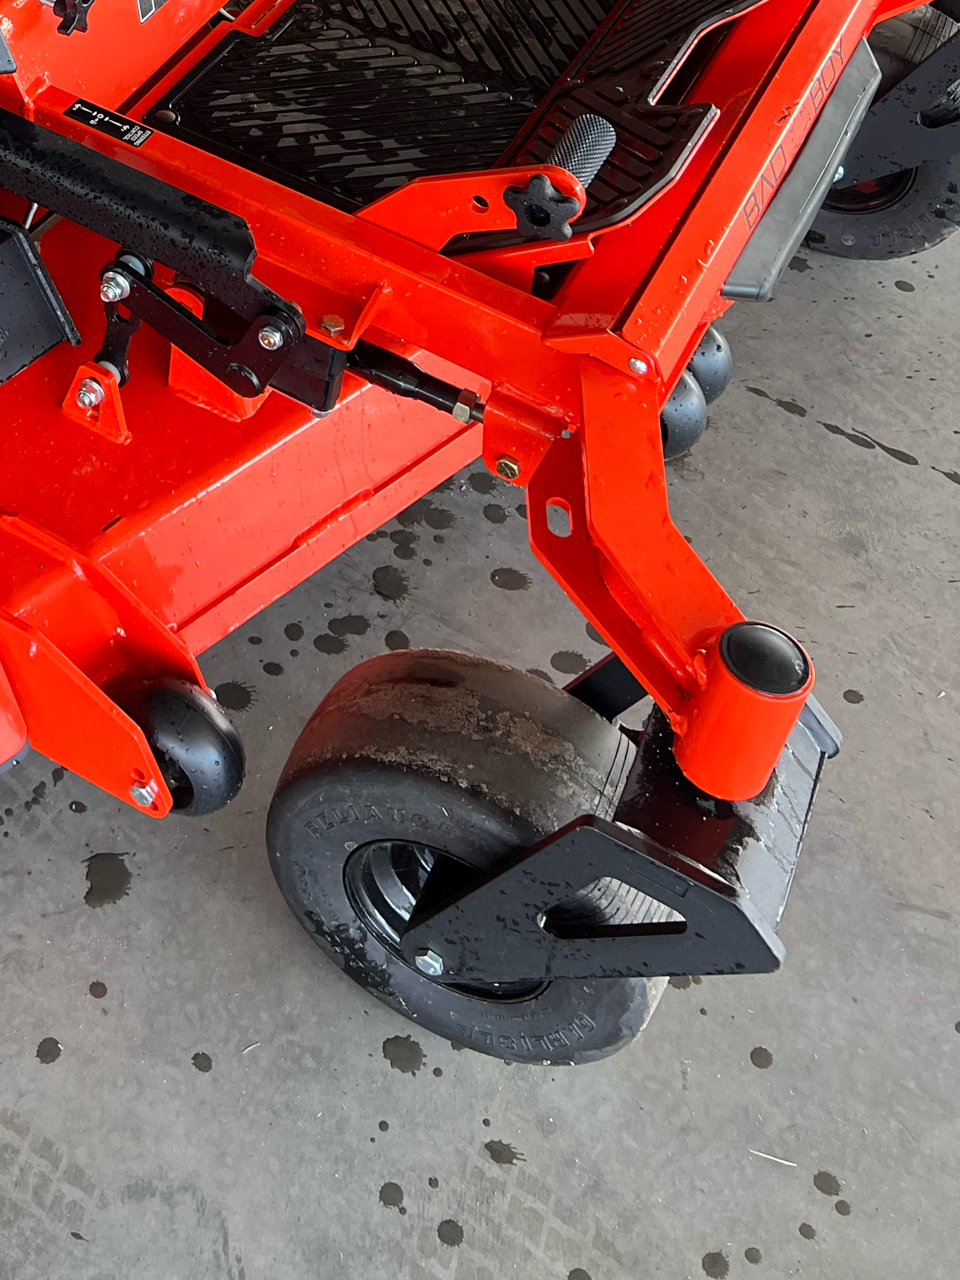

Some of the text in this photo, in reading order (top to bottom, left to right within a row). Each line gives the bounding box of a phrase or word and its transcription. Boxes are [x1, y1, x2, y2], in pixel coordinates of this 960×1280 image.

[742, 32, 846, 231] BAD BOY
[303, 804, 458, 840] RELIANCE
[456, 1011, 597, 1051] CARLISLE
